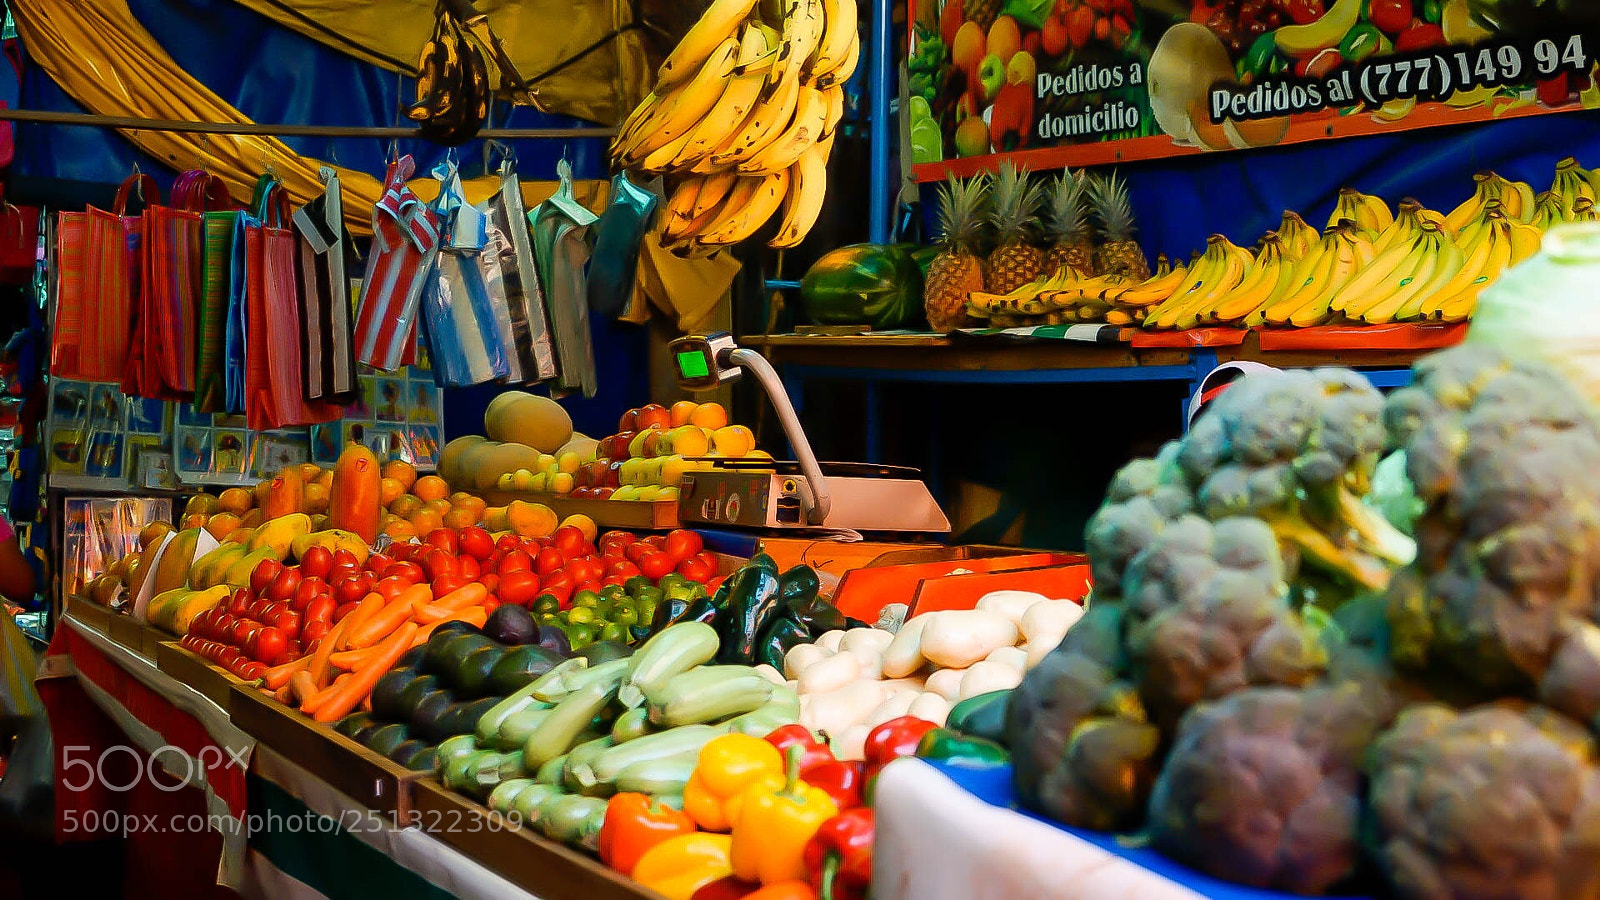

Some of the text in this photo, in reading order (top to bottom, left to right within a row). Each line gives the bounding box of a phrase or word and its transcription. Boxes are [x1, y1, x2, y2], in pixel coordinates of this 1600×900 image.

[1037, 62, 1142, 98] Pedidos a
[1212, 81, 1322, 118] Pedidos
[1327, 70, 1354, 102] al
[1534, 34, 1587, 74] 94
[1038, 101, 1139, 139] domicilio
